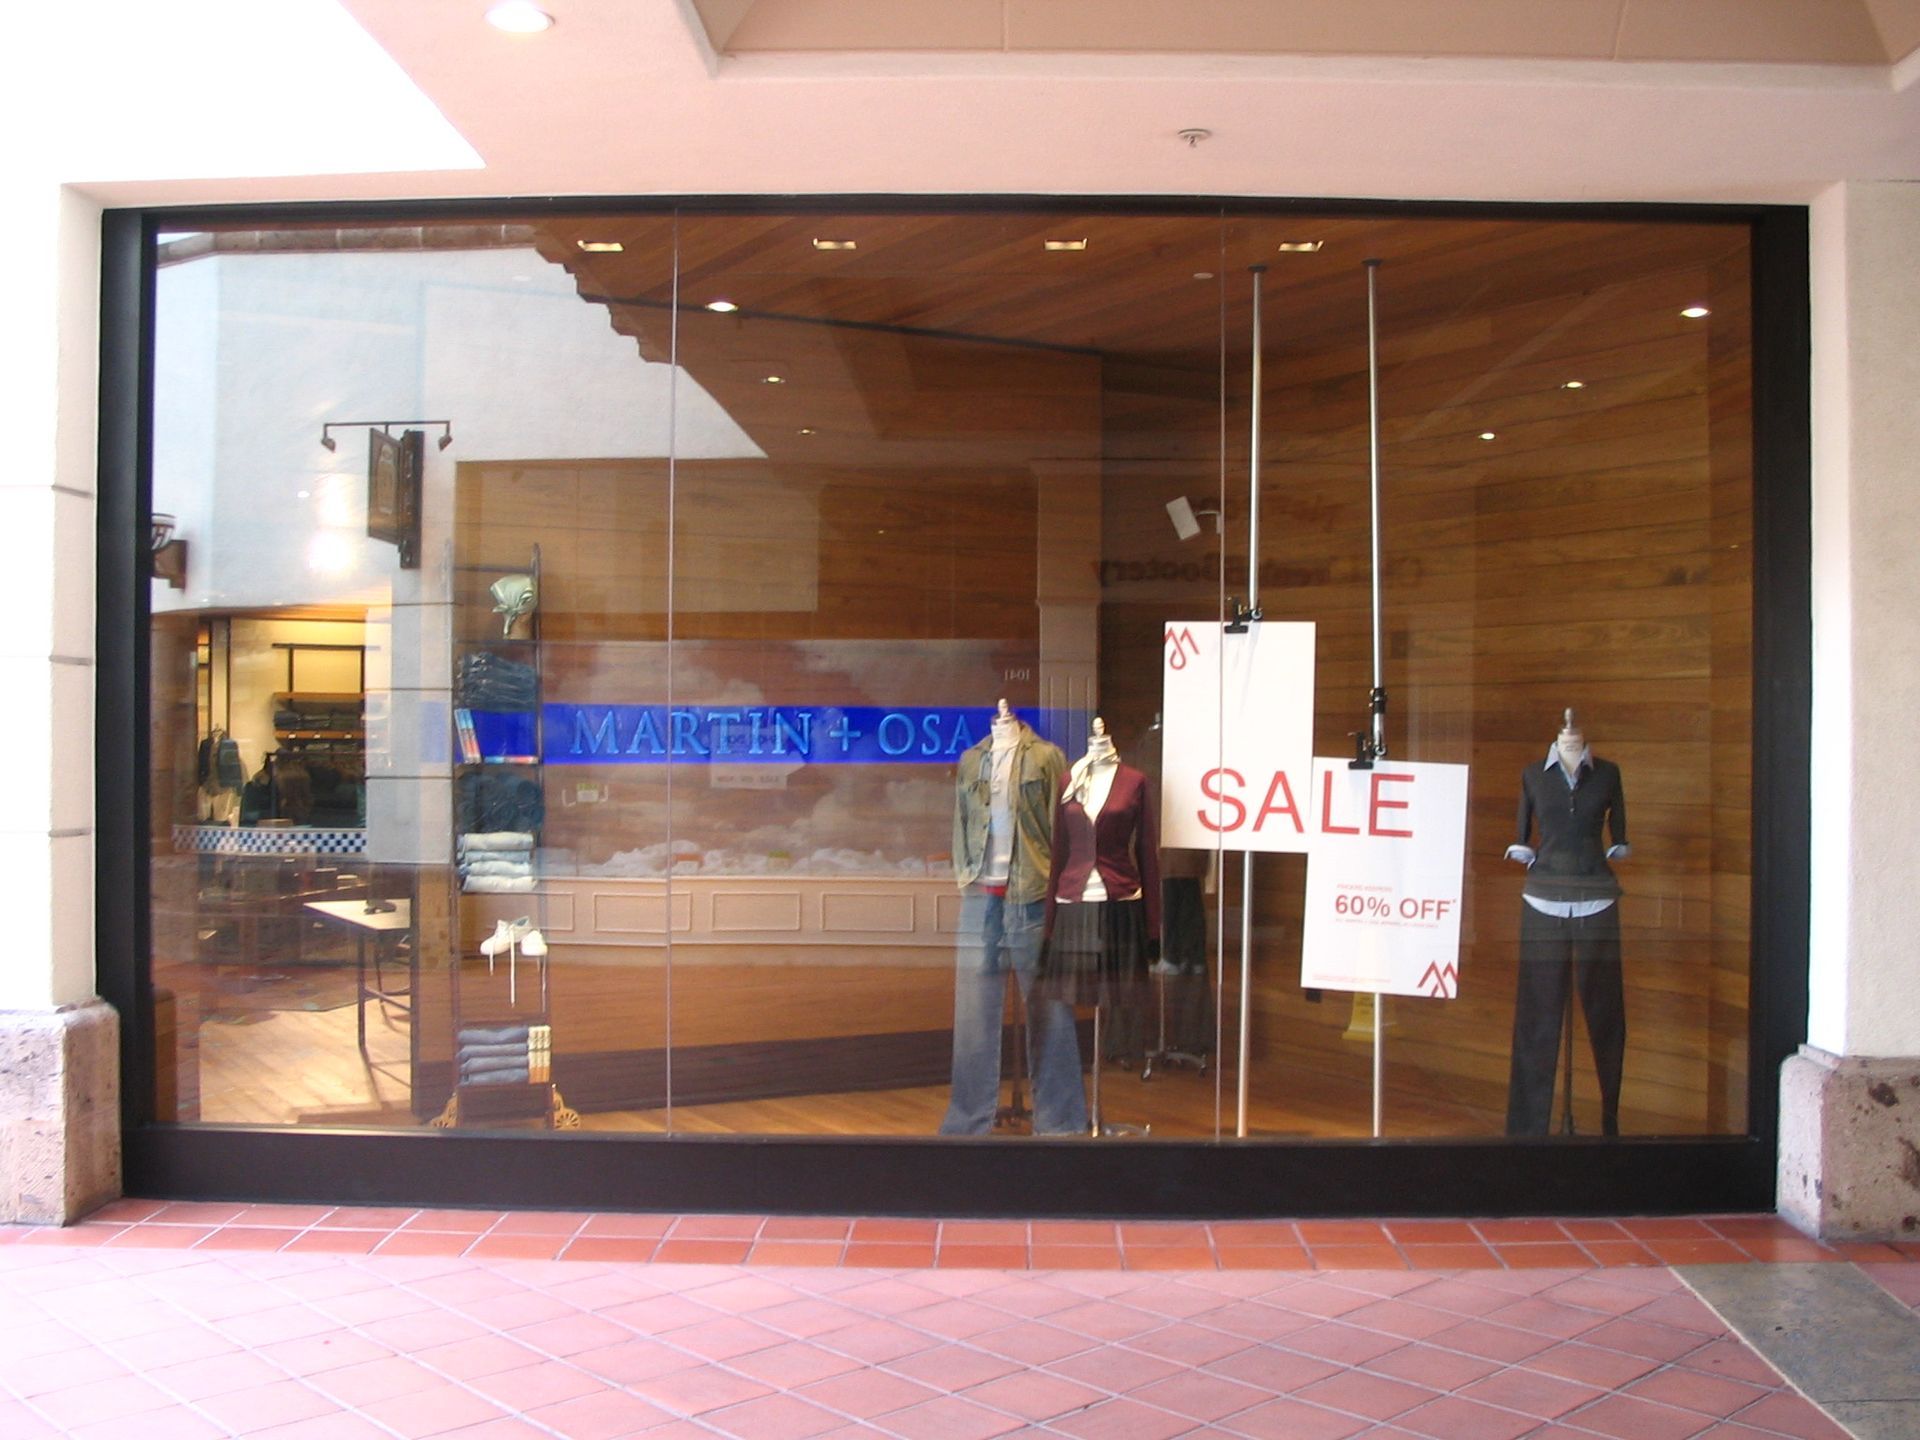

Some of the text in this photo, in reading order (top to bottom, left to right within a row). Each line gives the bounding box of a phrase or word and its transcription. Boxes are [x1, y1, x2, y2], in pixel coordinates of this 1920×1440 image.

[569, 709, 974, 755] MARTIN + OSA
[1197, 767, 1415, 838] SALE
[1335, 894, 1391, 917] 60%
